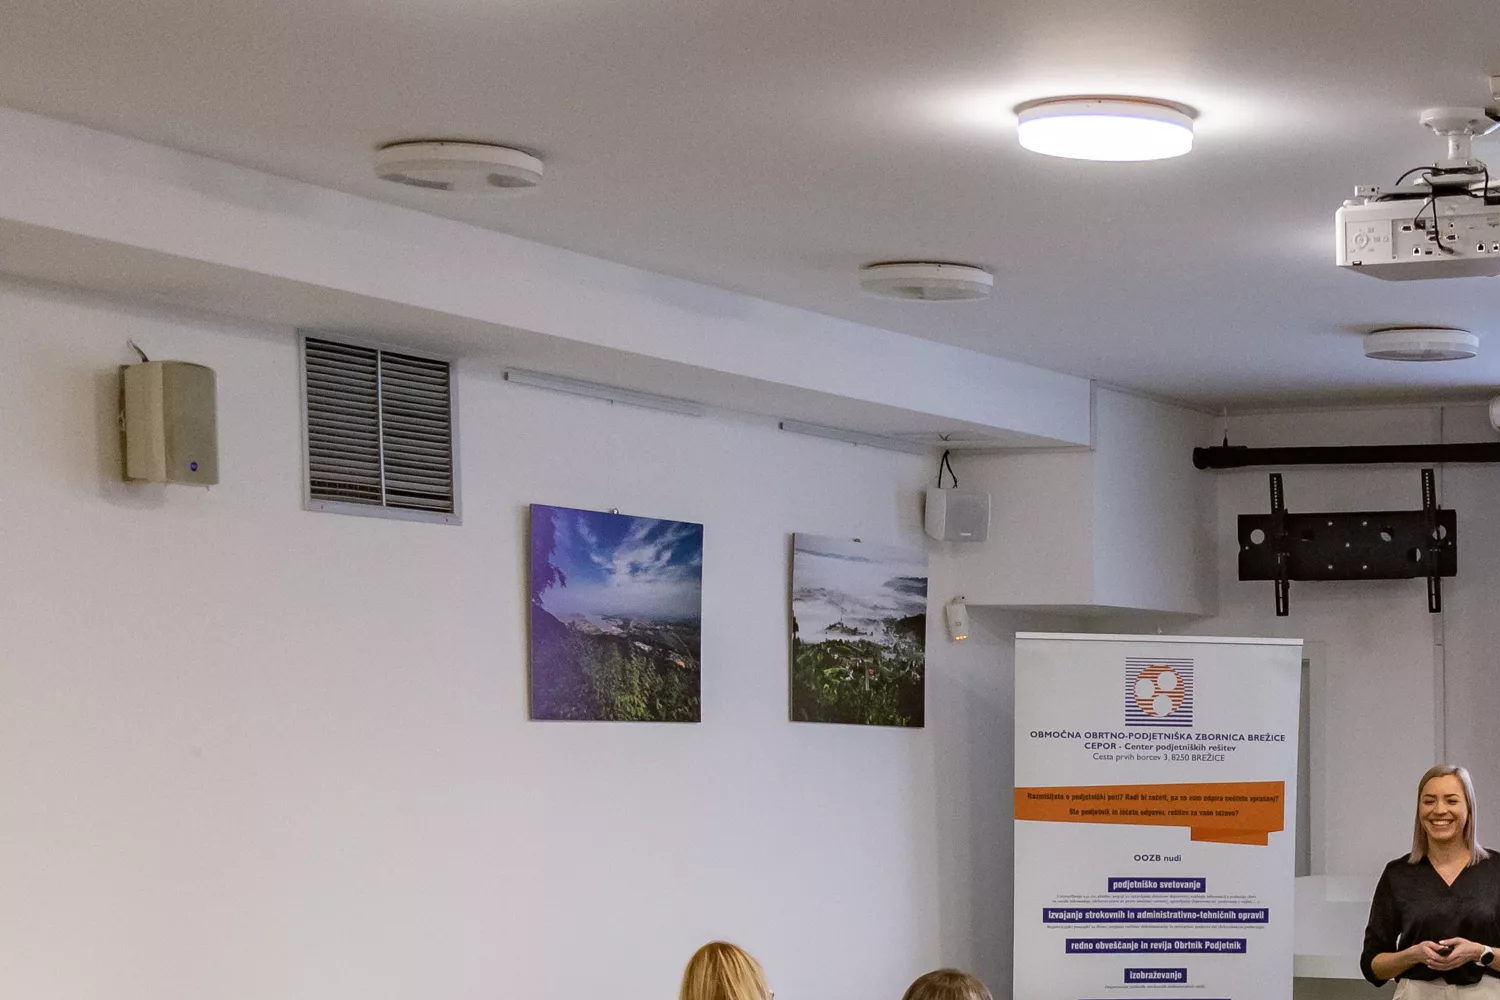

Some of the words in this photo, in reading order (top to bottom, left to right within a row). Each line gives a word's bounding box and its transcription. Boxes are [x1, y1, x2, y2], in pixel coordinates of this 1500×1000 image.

[1030, 730, 1081, 739] OBMOČNA
[1084, 731, 1193, 741] OBRTNO-PODJETNIŠKA
[1195, 733, 1245, 741] ZBORNICA
[1247, 733, 1286, 742] BREŽICE
[1084, 742, 1117, 750] CEPOR
[1156, 744, 1206, 752] podjetniških
[1208, 744, 1236, 752] rešitev
[1092, 752, 1114, 760] Cesta
[1116, 753, 1135, 762] prvih
[1192, 753, 1225, 762] BREŽICE
[1134, 854, 1161, 862] OOZB
[1113, 880, 1158, 890] podjetniško
[1159, 881, 1201, 890] svetovanje
[1085, 911, 1125, 919] strokovnih
[1127, 911, 1134, 919] in
[1136, 910, 1236, 919] administrativno-tehničnih
[1238, 911, 1264, 921] opravil
[1071, 941, 1093, 950] redno
[1095, 941, 1139, 951] obveščanje
[1141, 941, 1148, 949] in
[1150, 941, 1172, 951] revija
[1174, 941, 1203, 949] Obrtnik
[1205, 941, 1241, 951] Podjetnik
